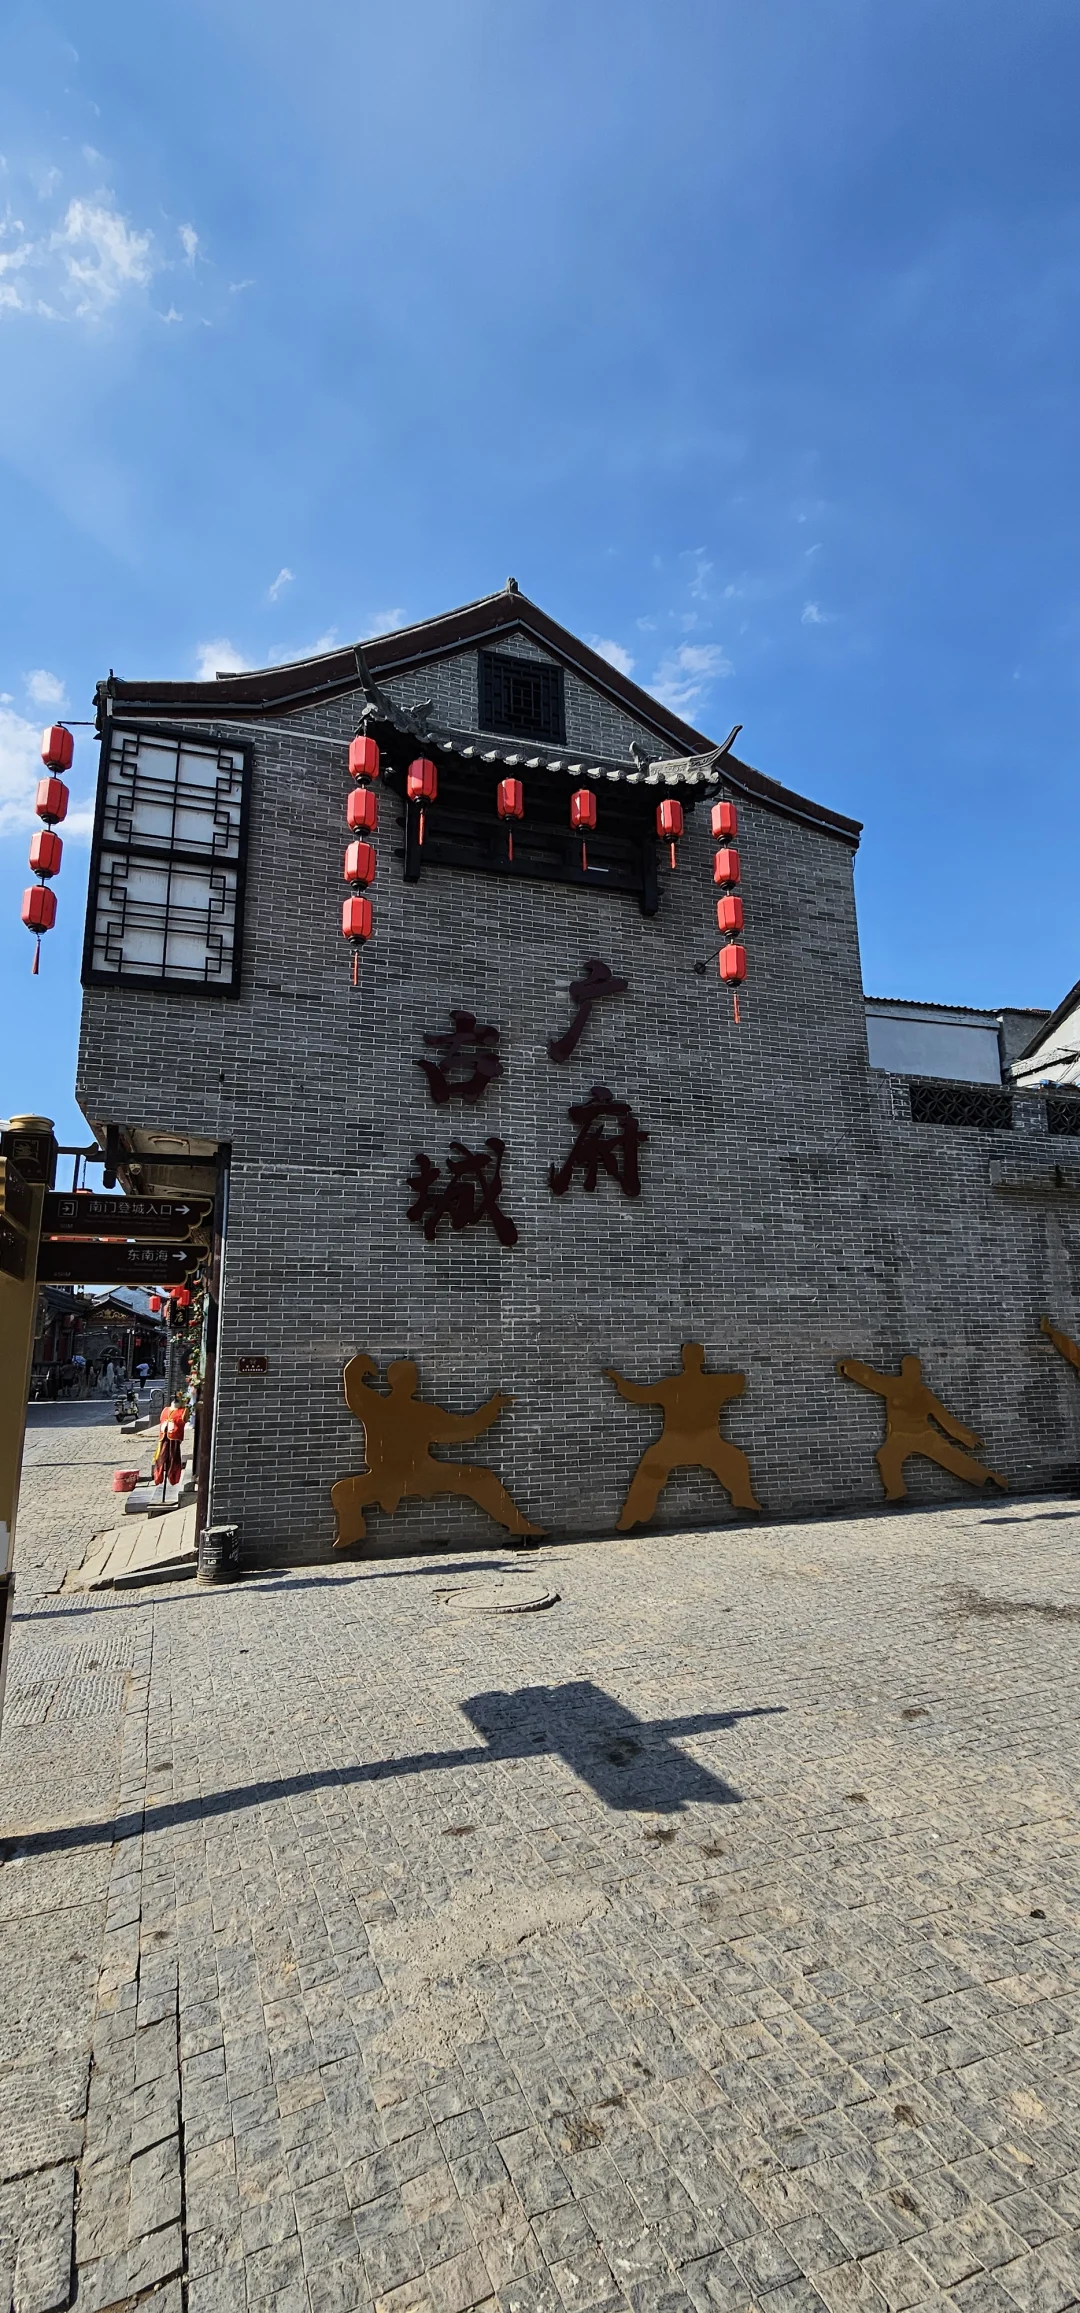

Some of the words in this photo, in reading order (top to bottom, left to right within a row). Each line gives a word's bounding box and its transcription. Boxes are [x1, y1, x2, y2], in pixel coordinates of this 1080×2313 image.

[406, 1010, 518, 1246] 古城
[547, 959, 649, 1198] 广府
[88, 1200, 172, 1216] 南门登城入口
[127, 1248, 168, 1262] 东南海
